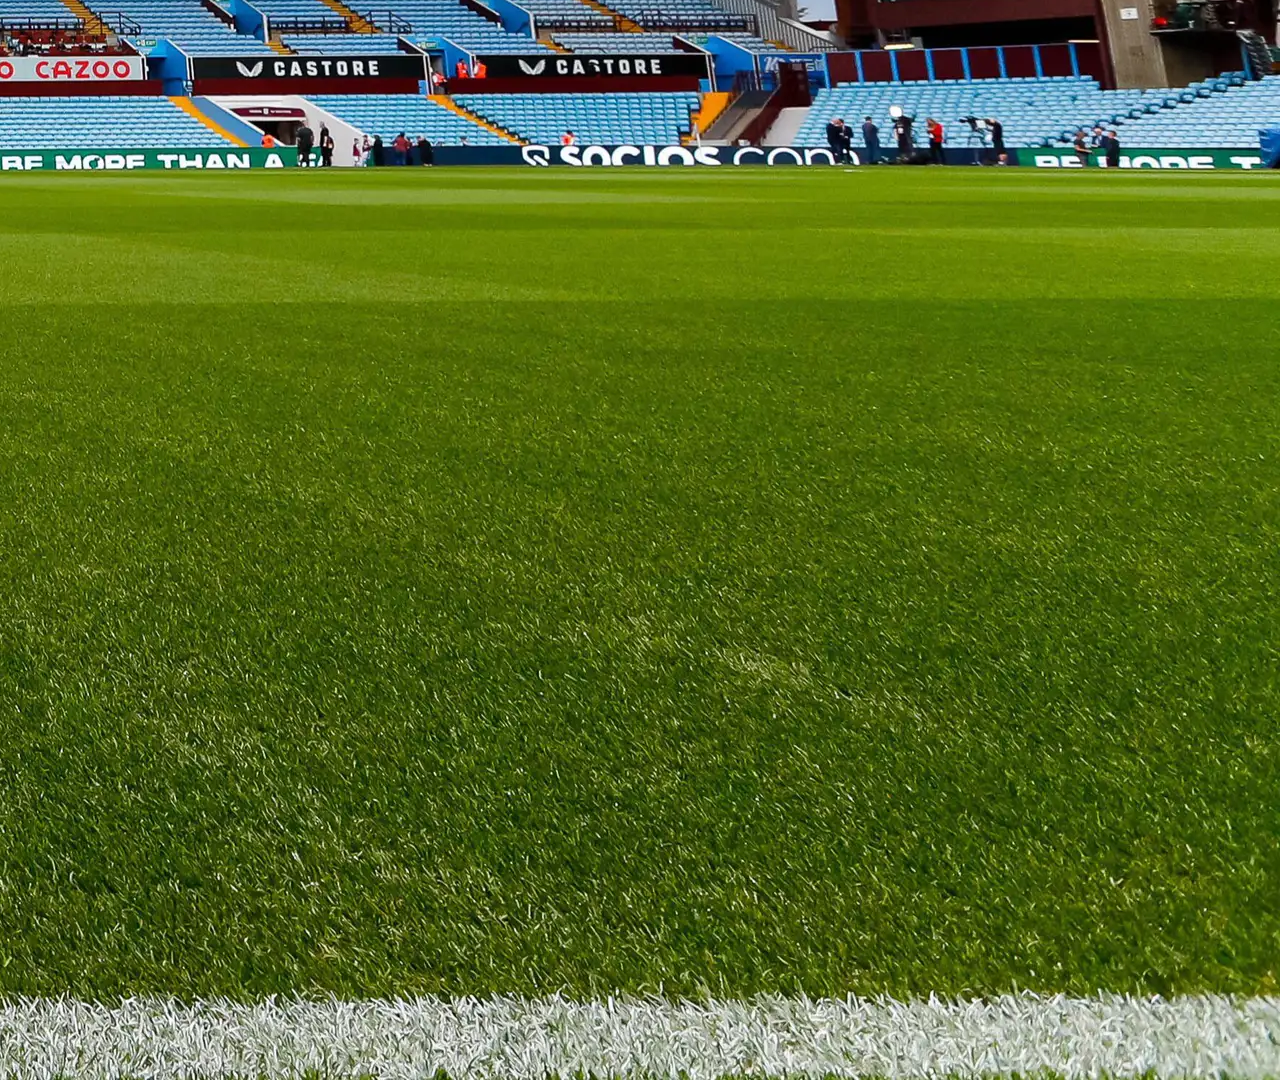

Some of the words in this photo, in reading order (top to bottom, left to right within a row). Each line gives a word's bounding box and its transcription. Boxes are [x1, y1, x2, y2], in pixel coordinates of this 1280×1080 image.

[35, 60, 131, 79] CAZOO
[274, 60, 379, 77] CASTORE
[157, 154, 251, 169] THAN
[264, 153, 284, 169] A
